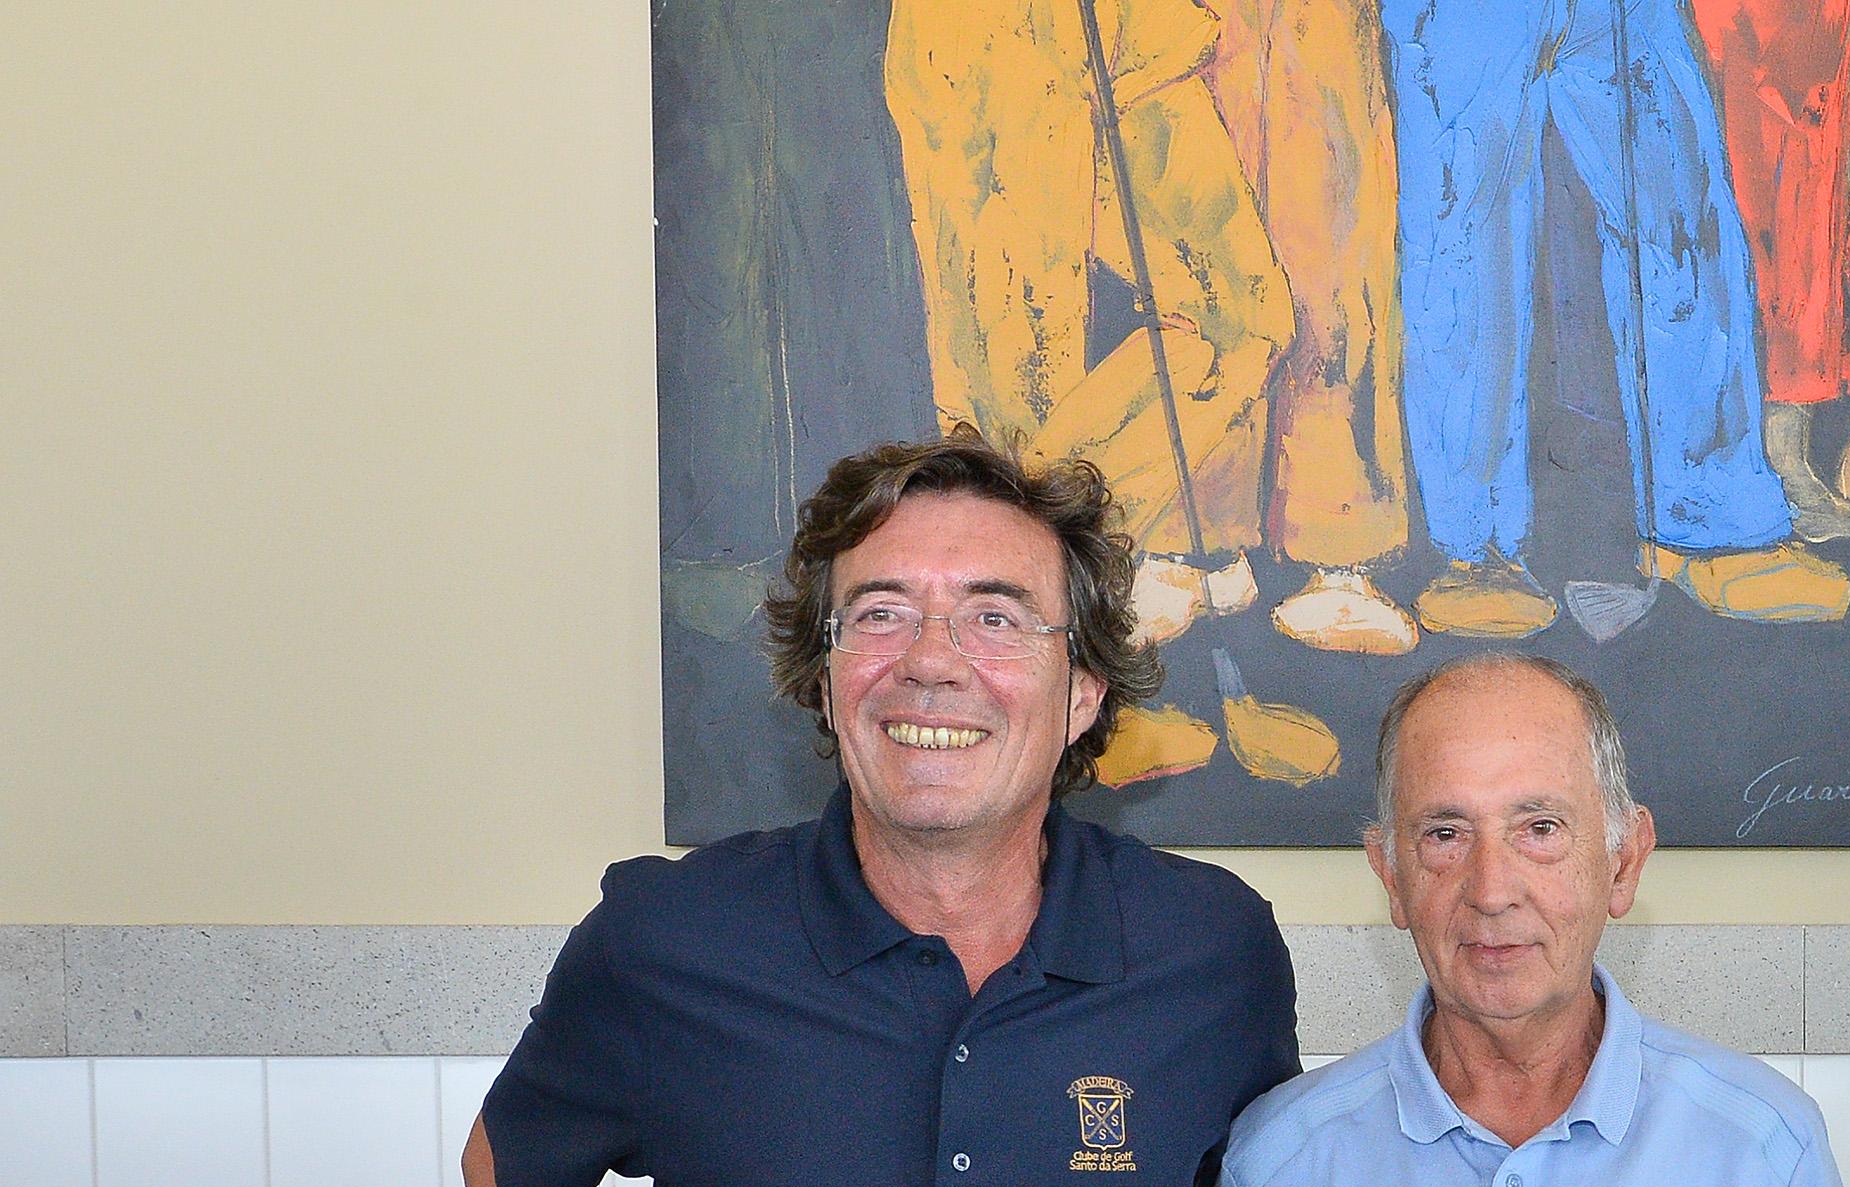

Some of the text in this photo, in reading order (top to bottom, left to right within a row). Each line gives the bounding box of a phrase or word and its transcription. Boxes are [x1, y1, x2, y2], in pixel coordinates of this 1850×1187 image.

[1097, 1102, 1106, 1113] G
[1085, 1115, 1119, 1126] C S
[1099, 1129, 1106, 1140] S
[1073, 1151, 1133, 1162] Clube de Golf
[1069, 1160, 1136, 1171] Santo da Serra
